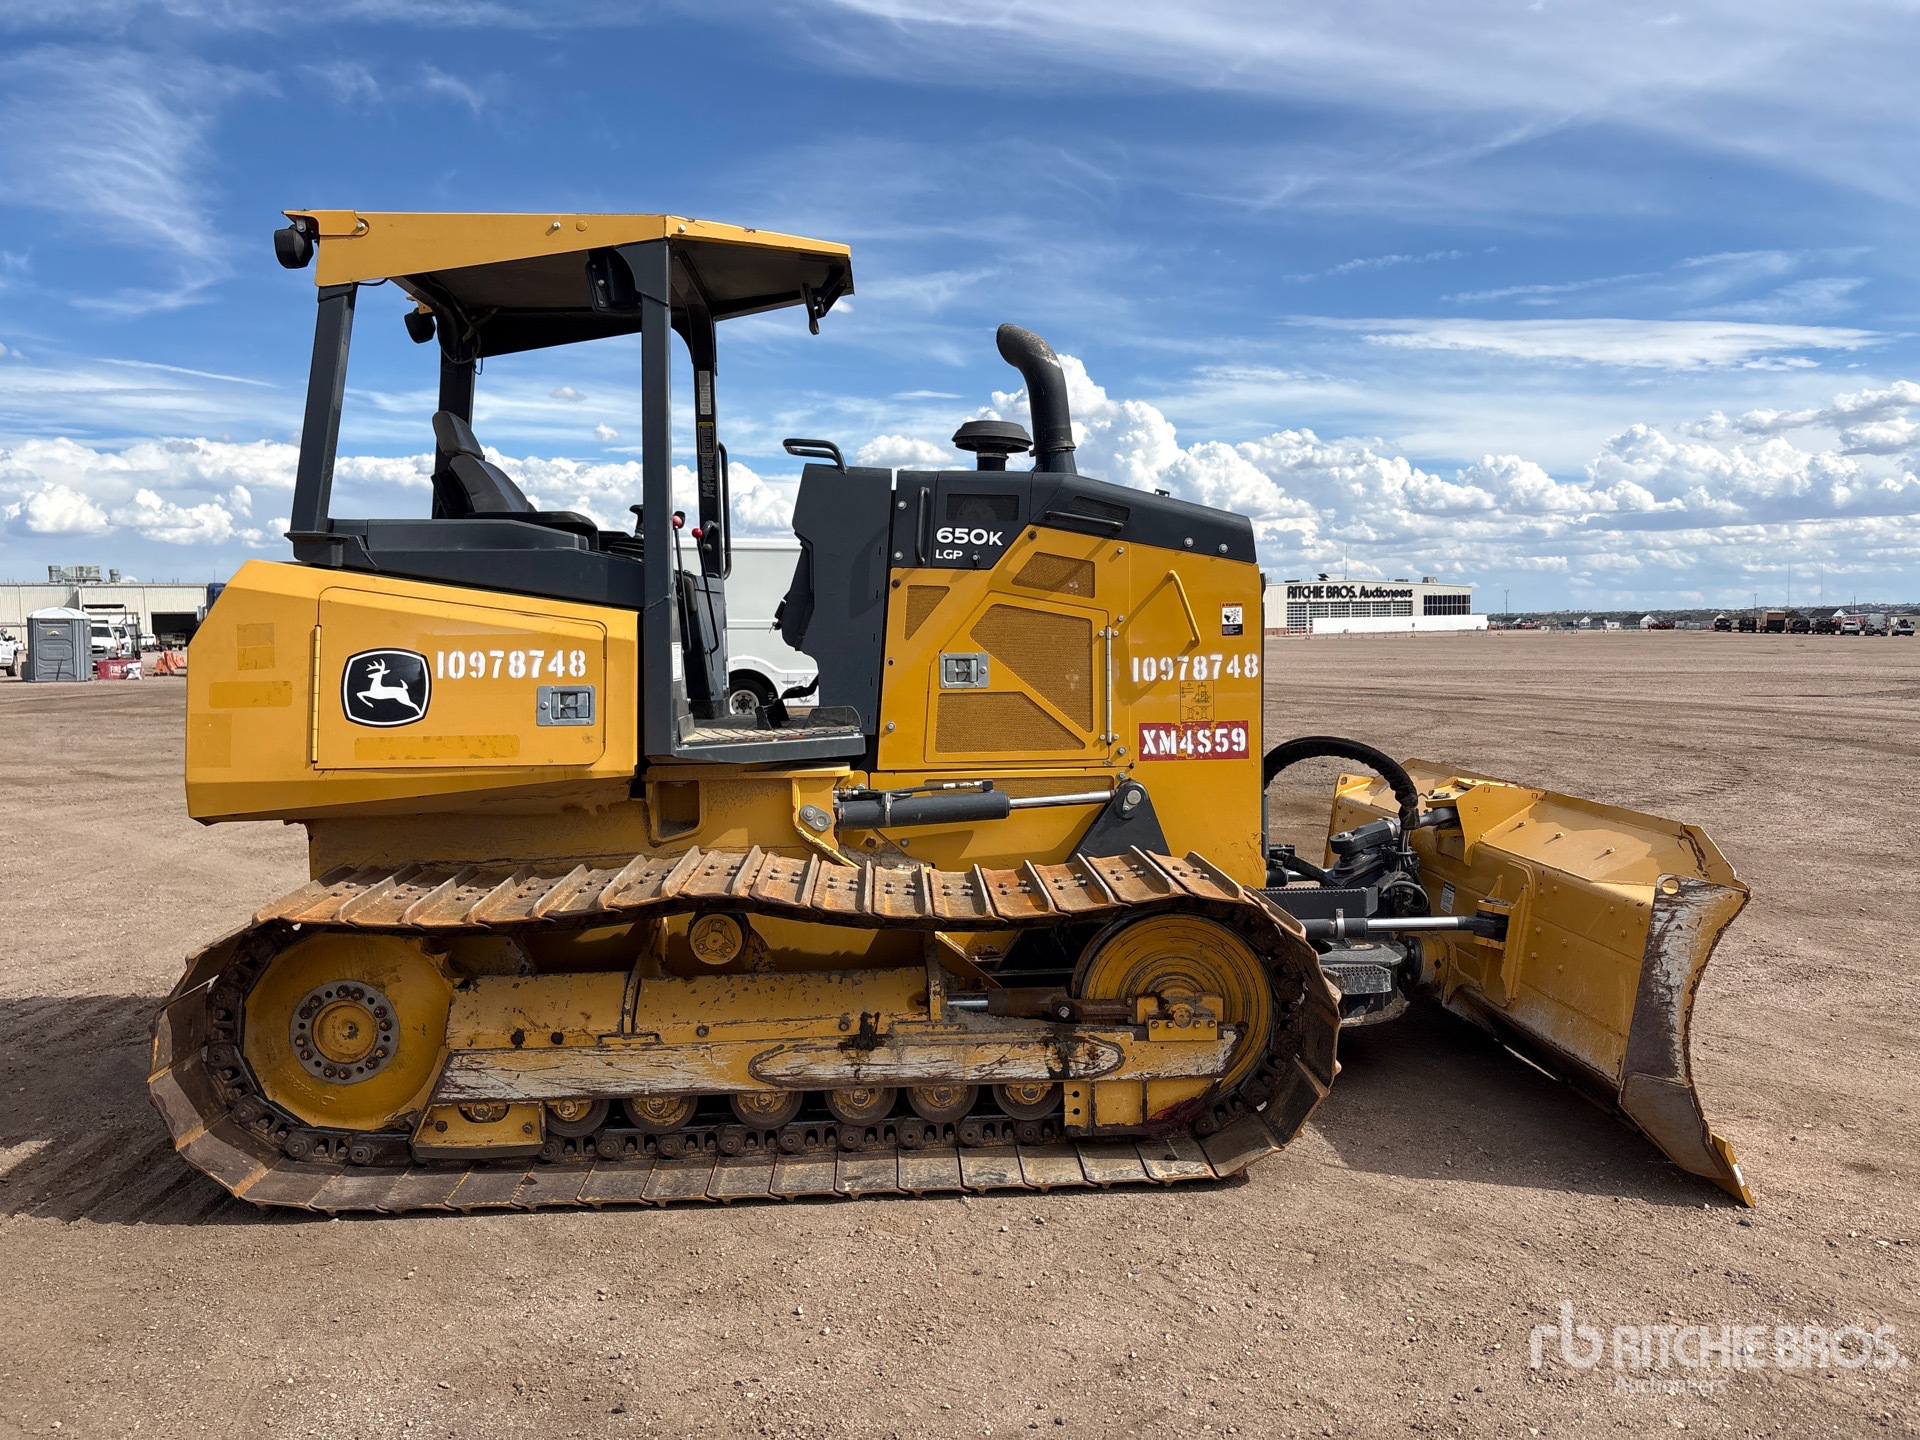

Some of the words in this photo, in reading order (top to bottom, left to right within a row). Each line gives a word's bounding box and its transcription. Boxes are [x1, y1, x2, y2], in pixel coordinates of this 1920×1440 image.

[936, 527, 1004, 546] 650K
[935, 549, 963, 560] LGP
[1287, 585, 1324, 599] RITCHIE
[1326, 585, 1357, 599] BROS.
[1359, 585, 1413, 599] Auctioneers
[1142, 727, 1247, 755] XM4S59
